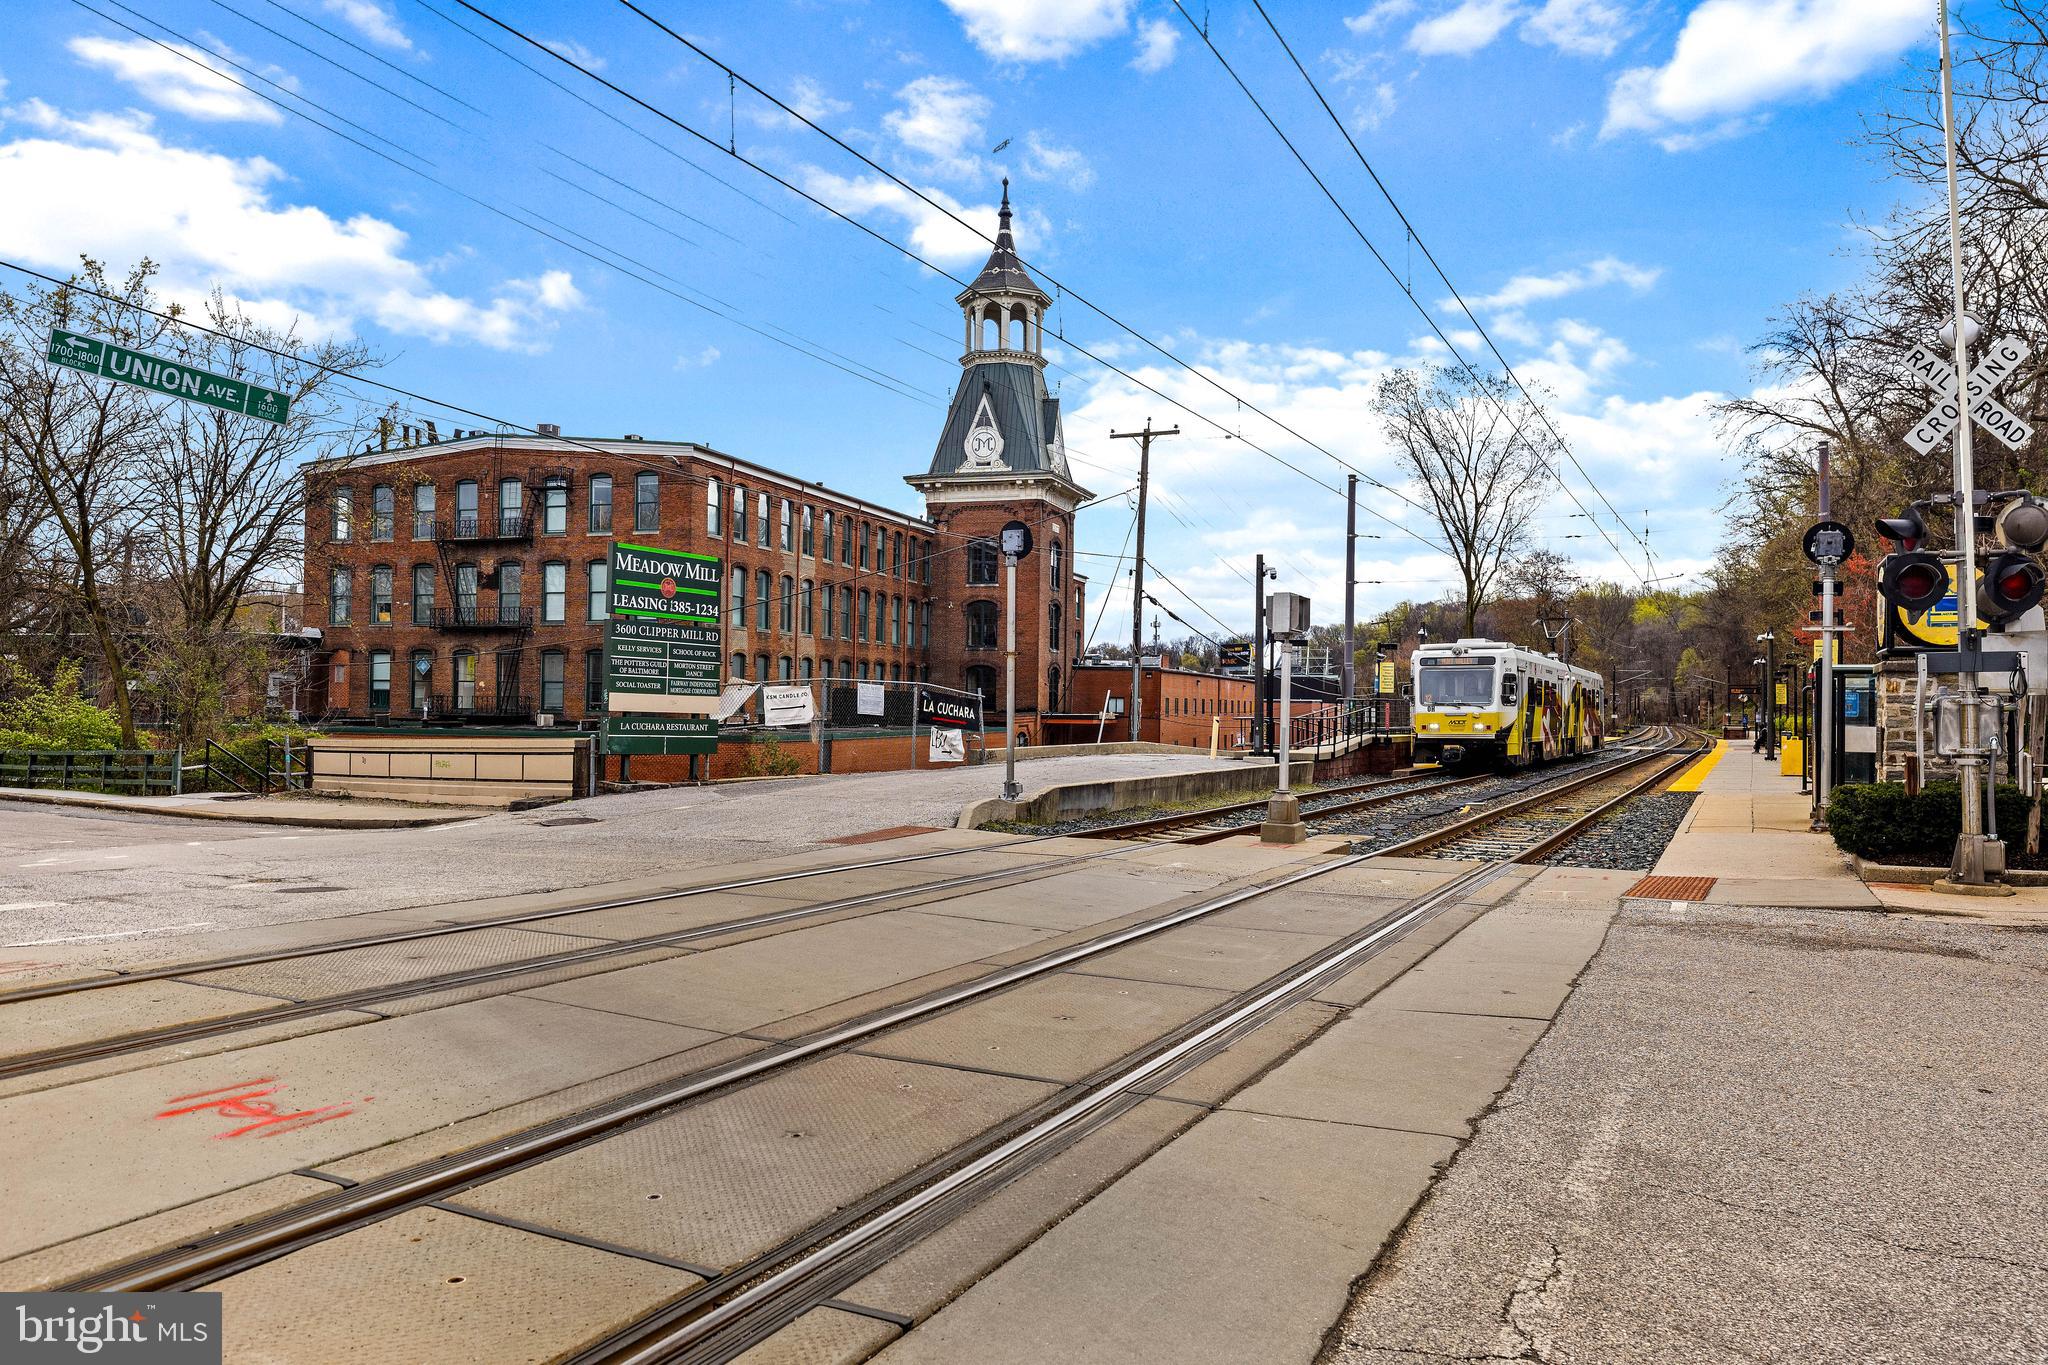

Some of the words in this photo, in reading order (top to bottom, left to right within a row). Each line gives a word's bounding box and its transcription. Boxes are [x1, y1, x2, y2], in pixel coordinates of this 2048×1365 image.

[50, 342, 100, 366] 1700-1800
[60, 356, 86, 369] BLOCKS
[110, 351, 200, 397] UNION
[204, 383, 240, 404] AVE.
[1906, 350, 1952, 391] RAIL
[1973, 400, 2026, 443] ROAD
[257, 401, 278, 414] 1600
[258, 410, 276, 420] BLOCK
[616, 552, 684, 578] MEADOW
[686, 562, 720, 582] MILL
[613, 594, 668, 611] LEASING
[615, 624, 636, 635] 3600
[638, 626, 679, 638] CLIPPER
[680, 630, 704, 640] MILL
[705, 632, 719, 641] RD
[672, 648, 694, 656] SCHOOL
[923, 700, 934, 712] LA
[937, 702, 975, 720] CUCHARA
